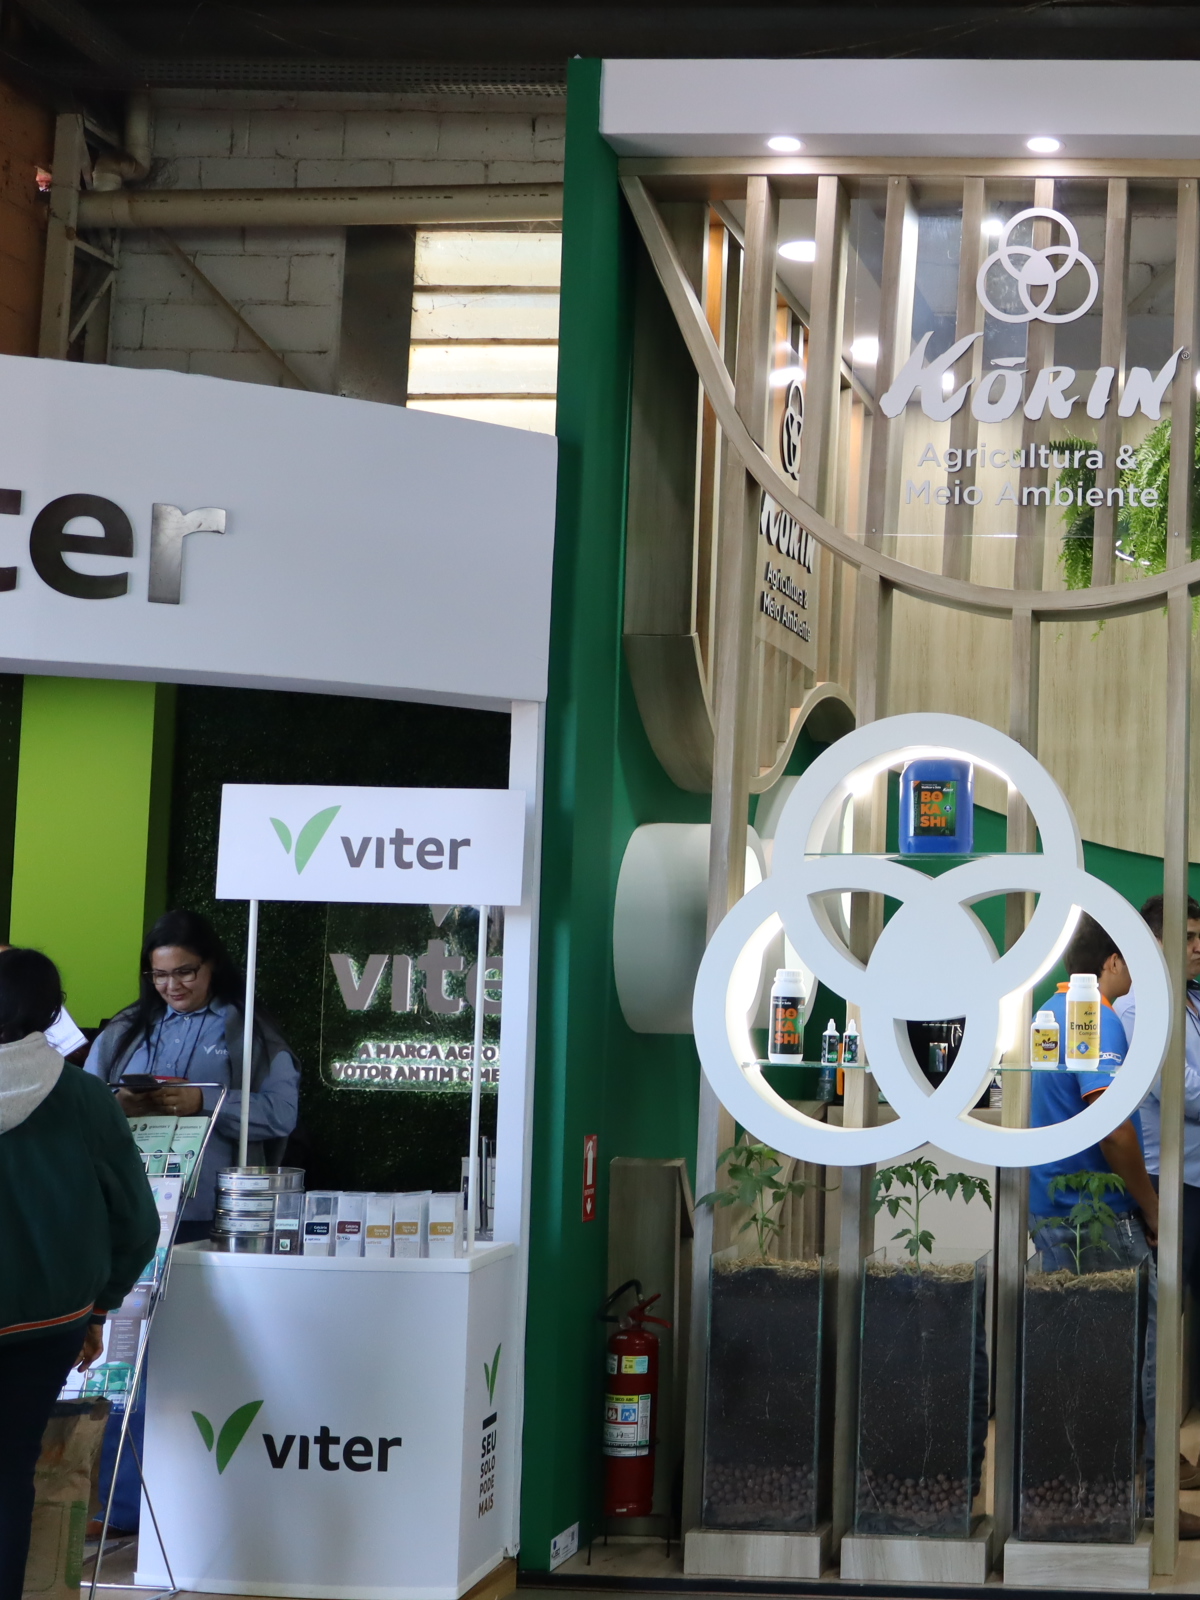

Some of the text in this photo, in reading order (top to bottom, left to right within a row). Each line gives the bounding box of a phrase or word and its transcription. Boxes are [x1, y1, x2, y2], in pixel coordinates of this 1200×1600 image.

[917, 443, 1138, 472] Agricultura &
[904, 480, 1159, 508] Meio Ambiente
[766, 561, 804, 607] Agricultura
[762, 590, 812, 643] Meio Ambiente
[919, 815, 947, 827] SHI
[920, 803, 942, 815] KA
[340, 828, 471, 871] viter
[329, 938, 503, 1014] vite
[359, 1043, 371, 1058] A
[376, 1044, 441, 1060] MARCA
[331, 1063, 453, 1081] VOTORANTIM
[263, 1426, 402, 1472] viter
[481, 1429, 497, 1458] SEU
[480, 1455, 496, 1479] SOLO
[479, 1474, 495, 1498] PODE
[478, 1493, 494, 1518] MAIS
